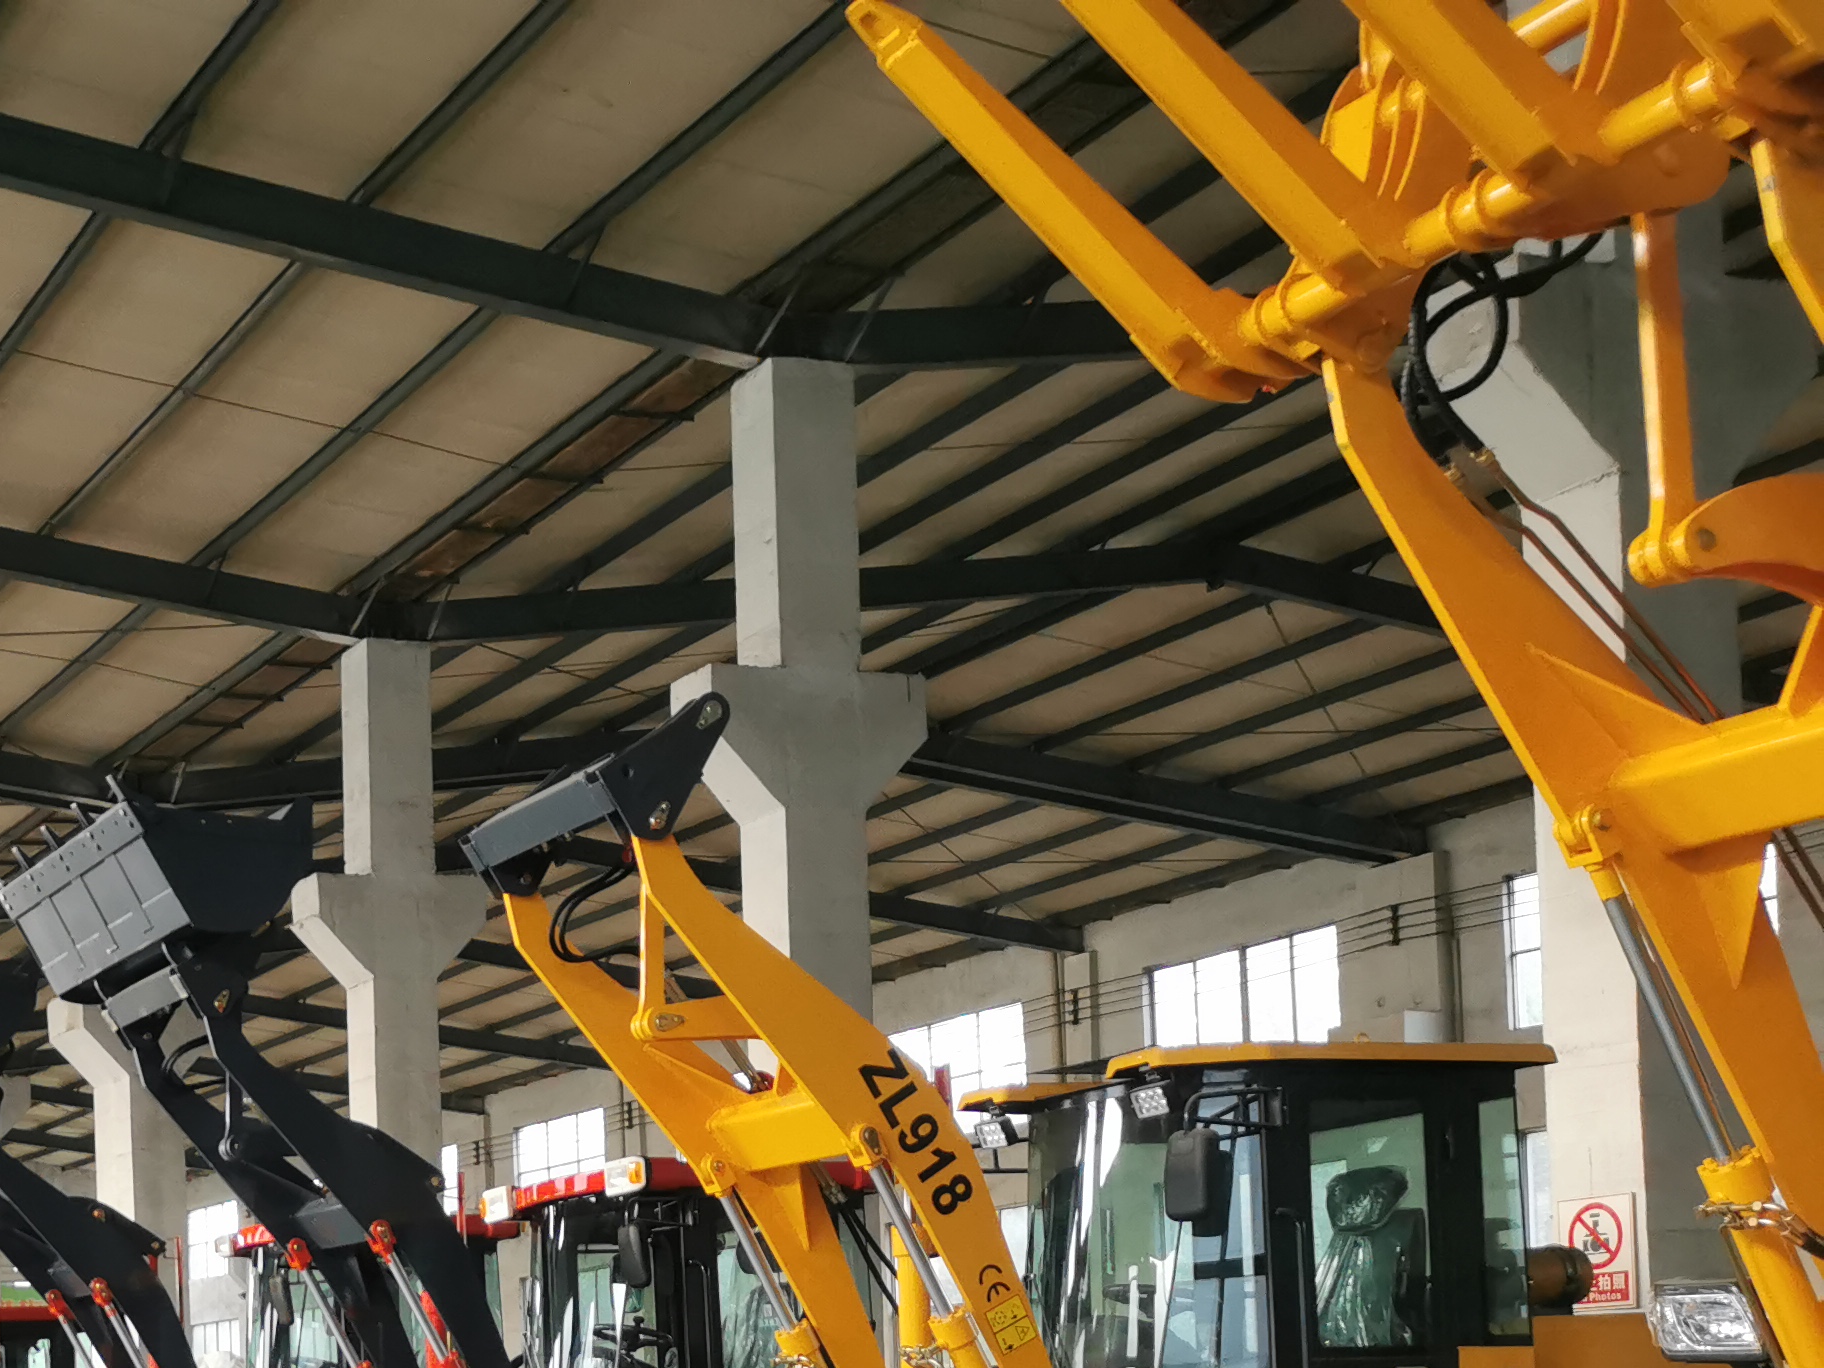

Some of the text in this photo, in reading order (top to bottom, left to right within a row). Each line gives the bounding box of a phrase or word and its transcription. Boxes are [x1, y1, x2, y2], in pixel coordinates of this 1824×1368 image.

[858, 1048, 973, 1215] ZL918
[979, 1264, 1010, 1302] CE
[1588, 1292, 1622, 1302] Photos
